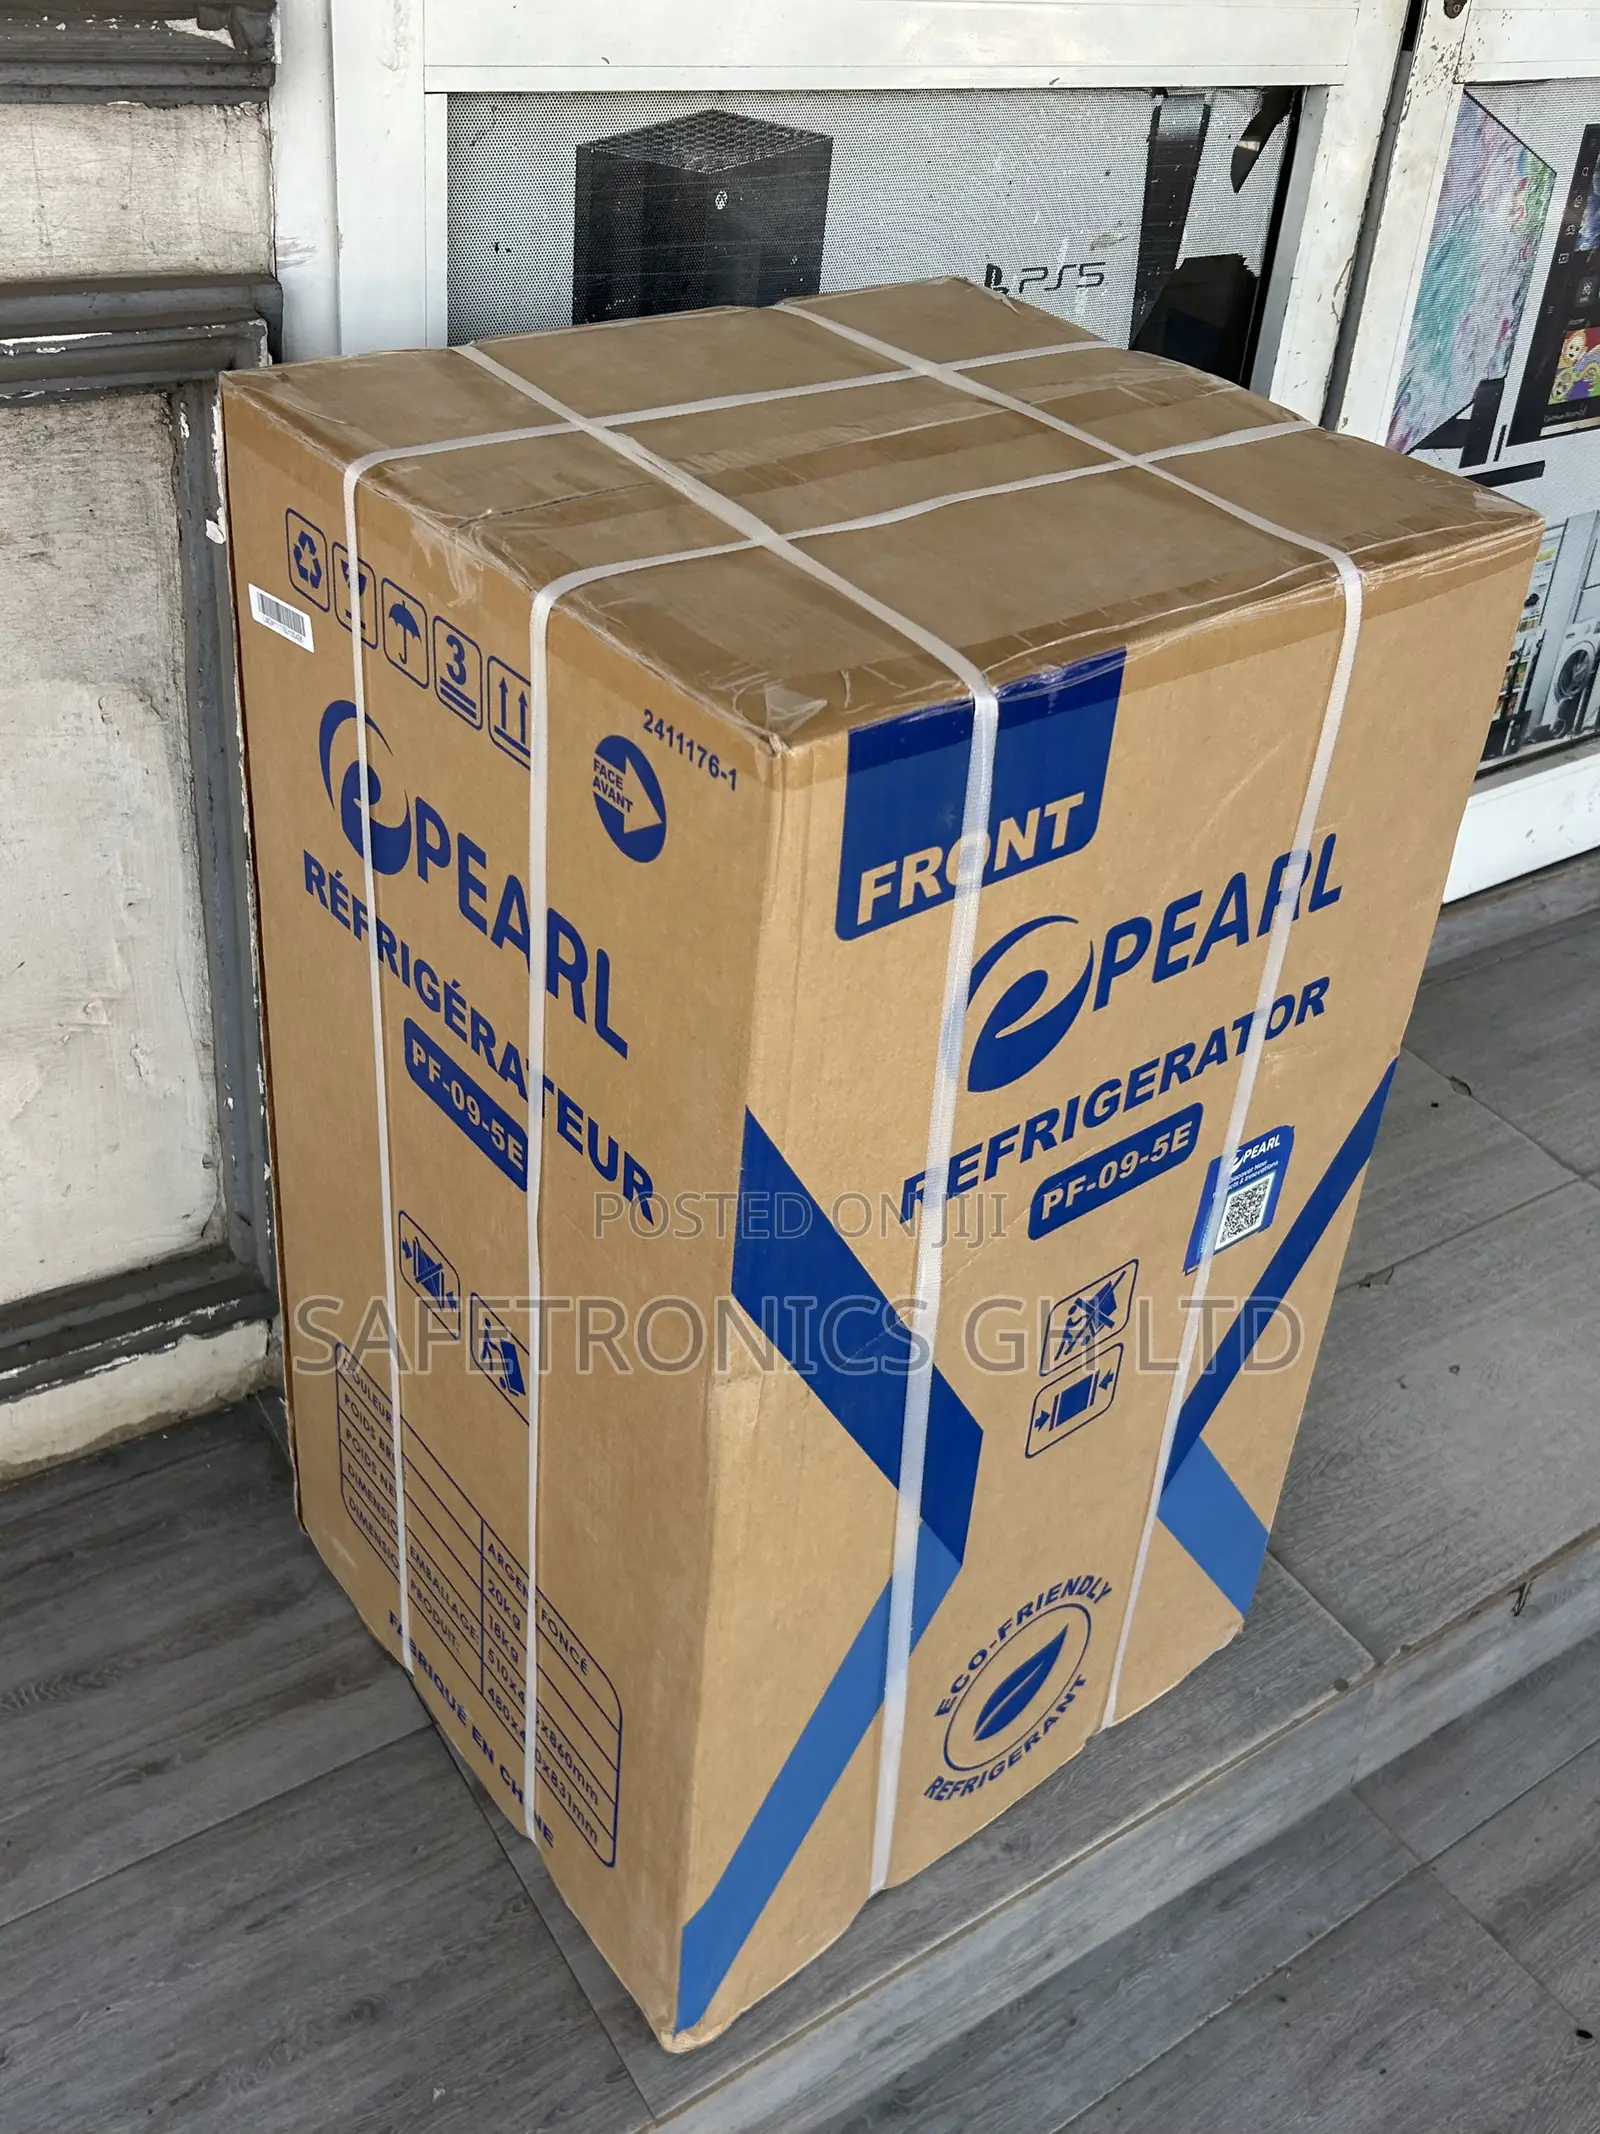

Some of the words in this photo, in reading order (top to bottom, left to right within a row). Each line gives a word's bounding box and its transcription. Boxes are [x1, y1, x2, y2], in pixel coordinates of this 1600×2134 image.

[1019, 261, 1106, 294] PS5
[593, 758, 623, 790] FACE
[643, 708, 737, 792] 2411176-1
[592, 775, 633, 813] AVANT
[415, 796, 628, 1060] PEARL
[411, 1038, 525, 1171] PF-09-5E
[1041, 1120, 1193, 1200] PF-09-5E
[1242, 1134, 1280, 1164] PEARL
[344, 1392, 376, 1441] POIDS
[346, 1428, 378, 1476] POIDS
[410, 1578, 460, 1652] PRODUIT:
[541, 1606, 588, 1677] FONCÉ
[934, 1575, 1113, 1718] ECO-FRIENDLY
[472, 1725, 494, 1765] EN
[923, 1673, 1087, 1802] REFRIGERANT
